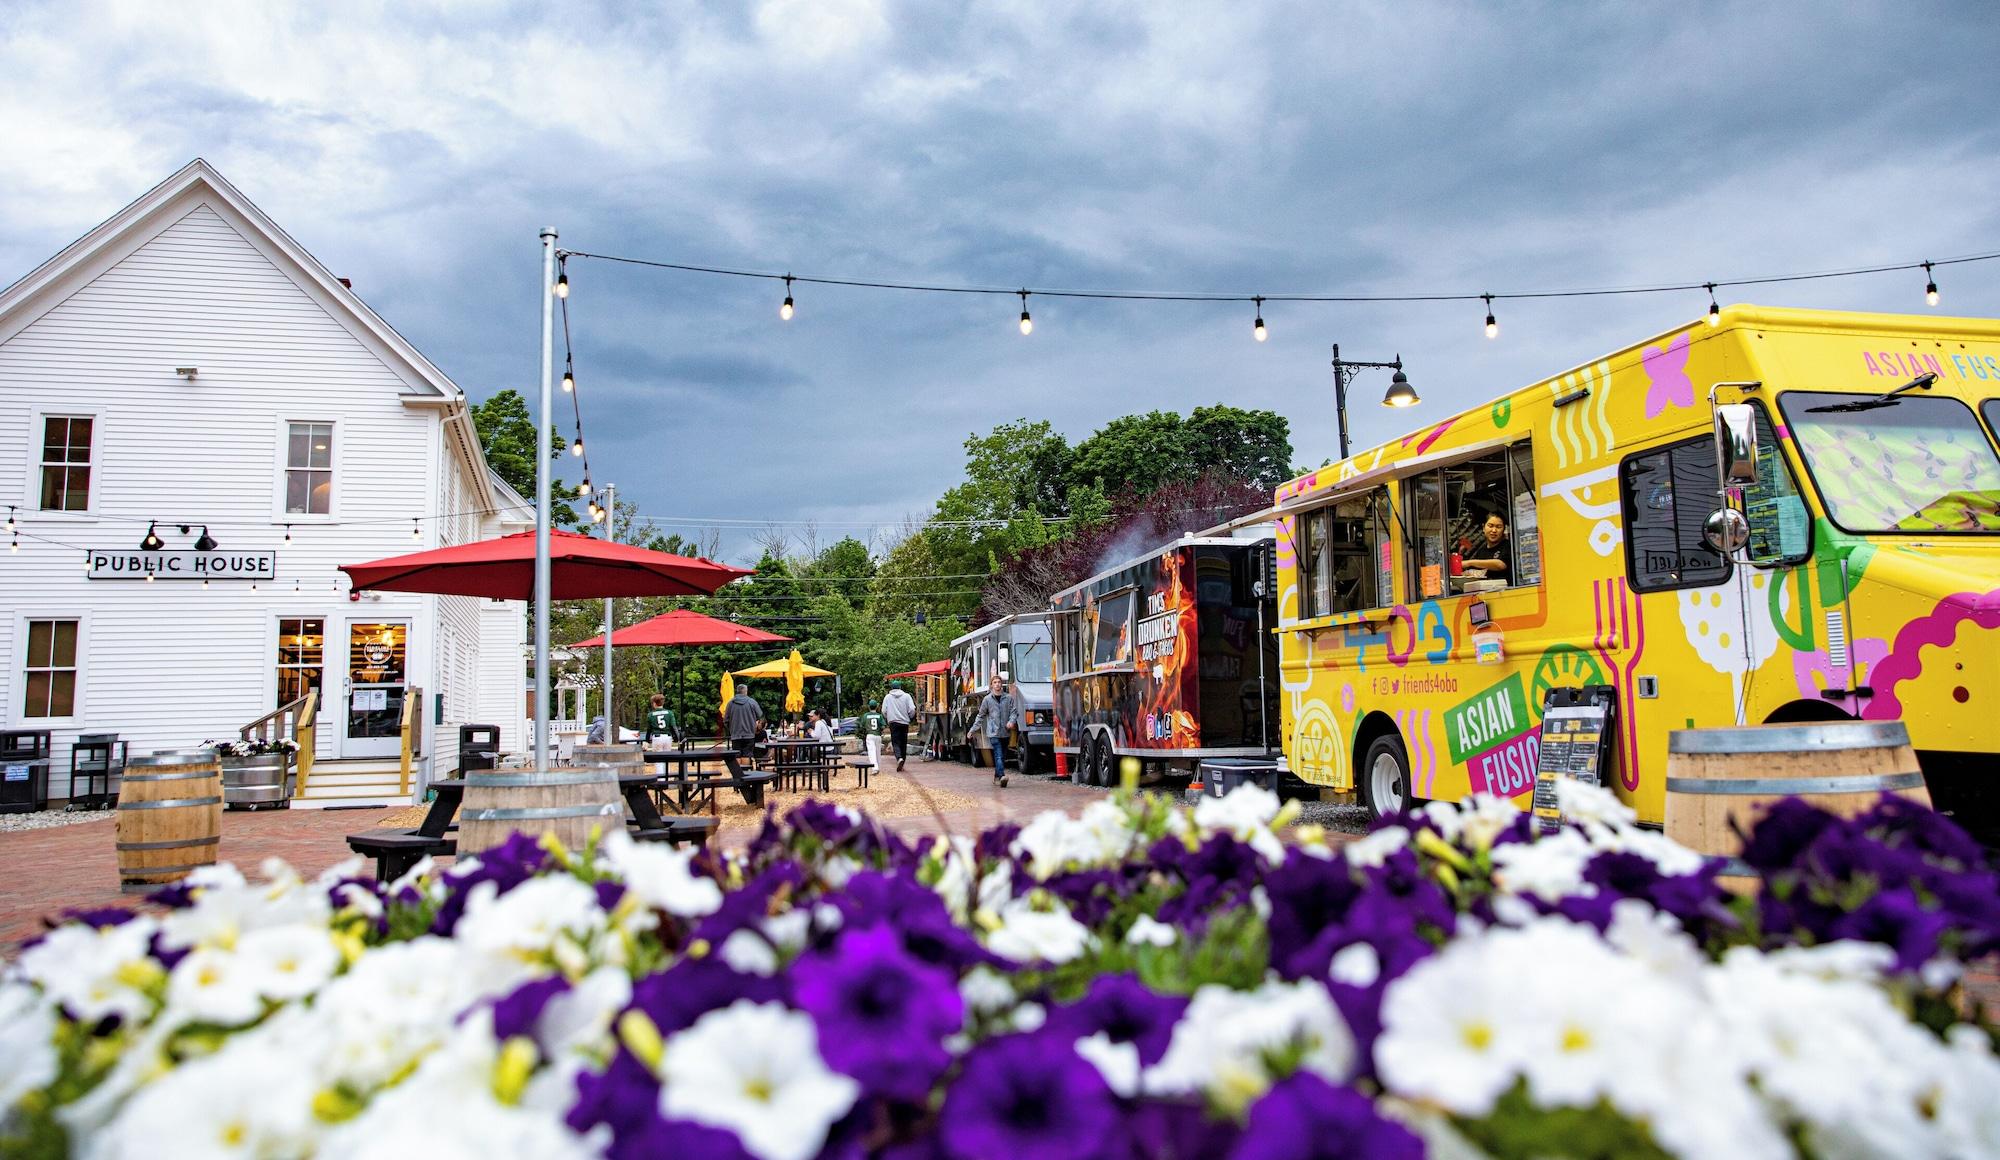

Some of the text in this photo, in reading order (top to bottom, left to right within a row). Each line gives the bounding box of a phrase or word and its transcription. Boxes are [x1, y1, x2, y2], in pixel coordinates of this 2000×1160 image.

[1863, 352, 1946, 378] ASIAN
[94, 556, 269, 572] PUBLIC HOUSE
[1138, 614, 1177, 645] DRUNKEN
[1142, 644, 1154, 661] BBQ
[1158, 638, 1174, 657] TACOS
[1403, 672, 1458, 694] friends4oba
[656, 715, 667, 729] 5
[870, 718, 878, 730] 9
[1457, 687, 1515, 753] ASIAN
[1482, 732, 1541, 799] FUSIO
